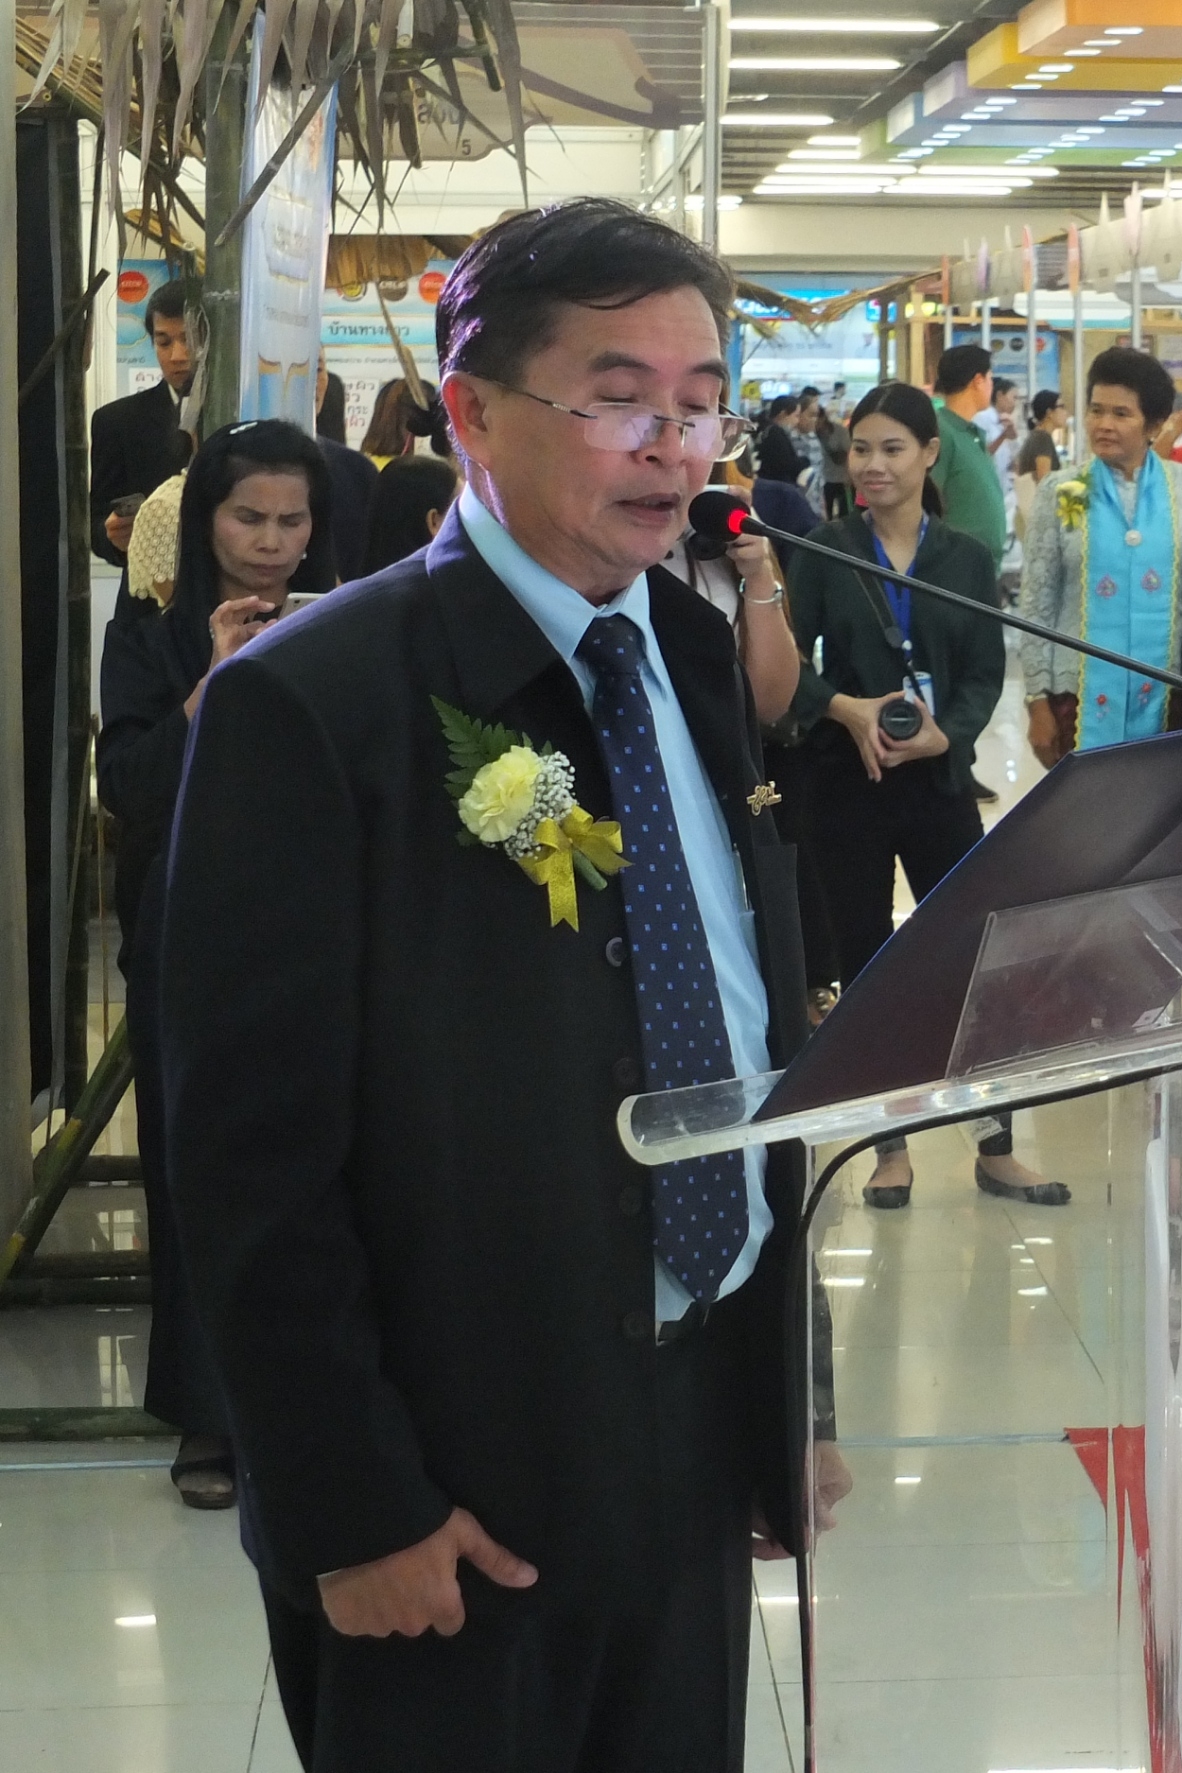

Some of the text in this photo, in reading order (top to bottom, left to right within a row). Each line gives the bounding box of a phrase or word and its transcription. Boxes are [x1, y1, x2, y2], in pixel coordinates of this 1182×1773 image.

[461, 139, 472, 156] 5
[328, 321, 410, 336] บ้านทางาว
